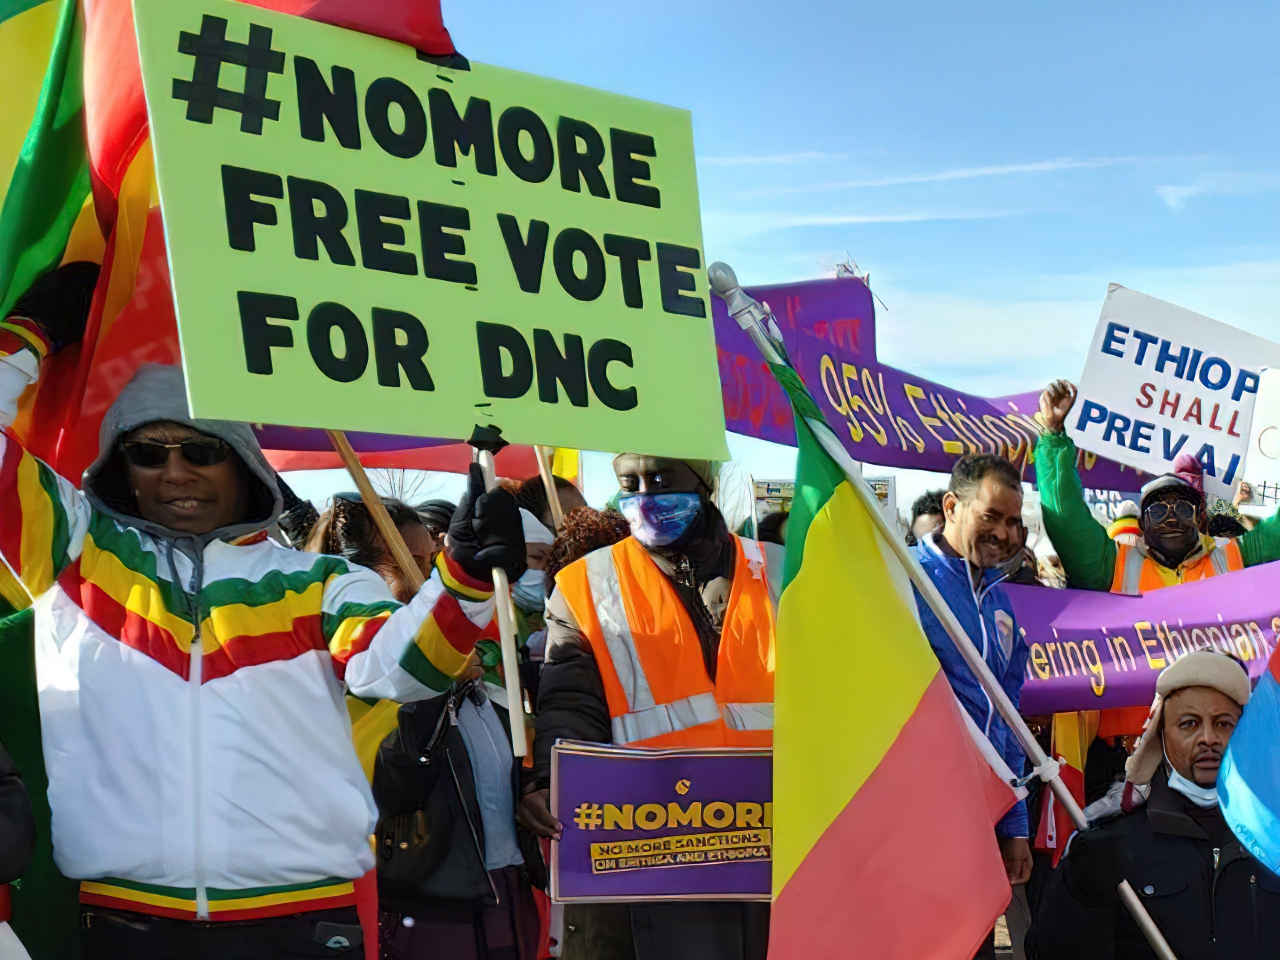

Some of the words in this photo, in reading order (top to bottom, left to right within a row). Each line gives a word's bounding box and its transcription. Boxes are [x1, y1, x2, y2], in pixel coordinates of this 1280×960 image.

[172, 14, 661, 209] #NOMORE
[221, 164, 478, 286] FREE
[497, 213, 706, 319] VOTE
[237, 290, 435, 393] FOR
[476, 321, 638, 412] DNC
[820, 354, 925, 454] 95%
[1136, 382, 1241, 438] SHALL
[1101, 627, 1137, 672] in
